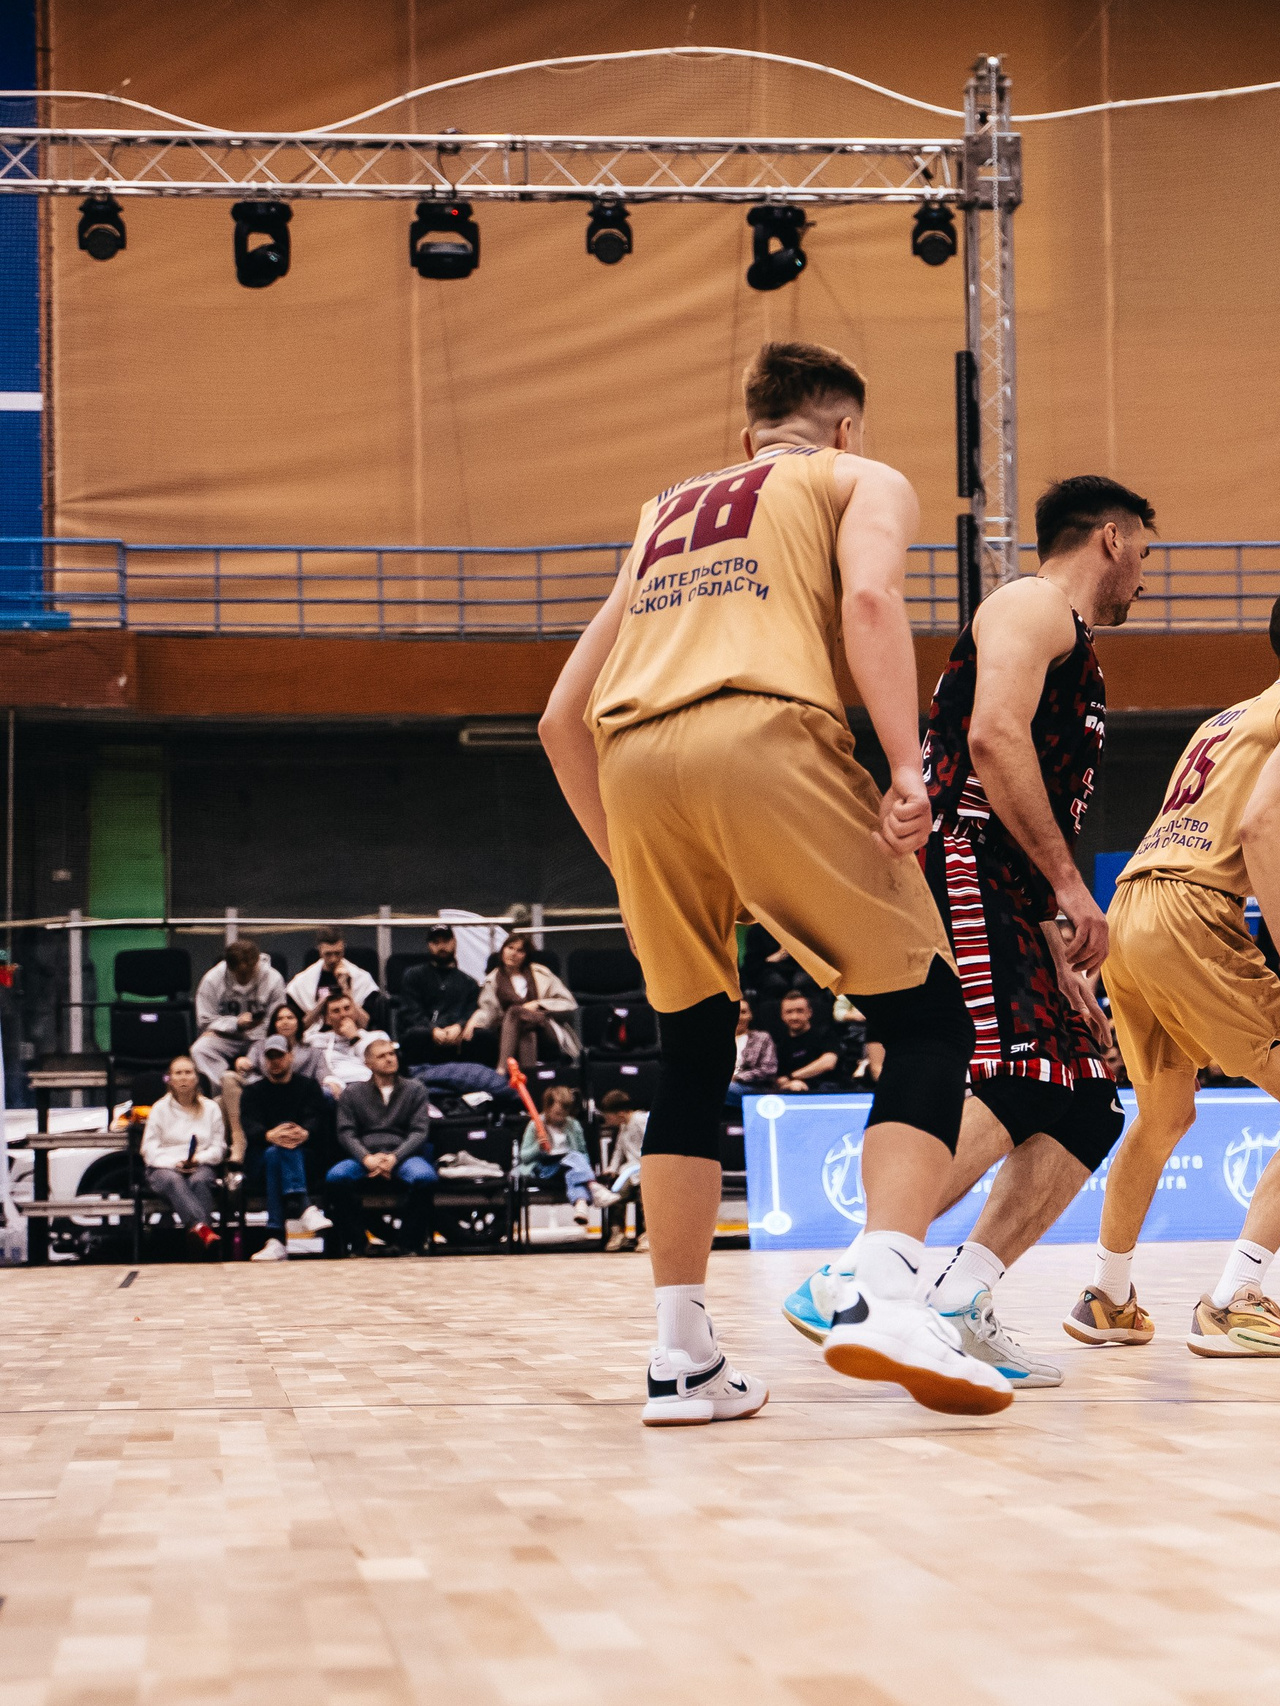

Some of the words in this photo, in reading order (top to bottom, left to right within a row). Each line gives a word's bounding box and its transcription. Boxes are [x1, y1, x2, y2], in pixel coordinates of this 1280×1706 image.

[637, 463, 776, 580] 28
[1162, 727, 1233, 815] 15
[1010, 1042, 1036, 1053] STK
